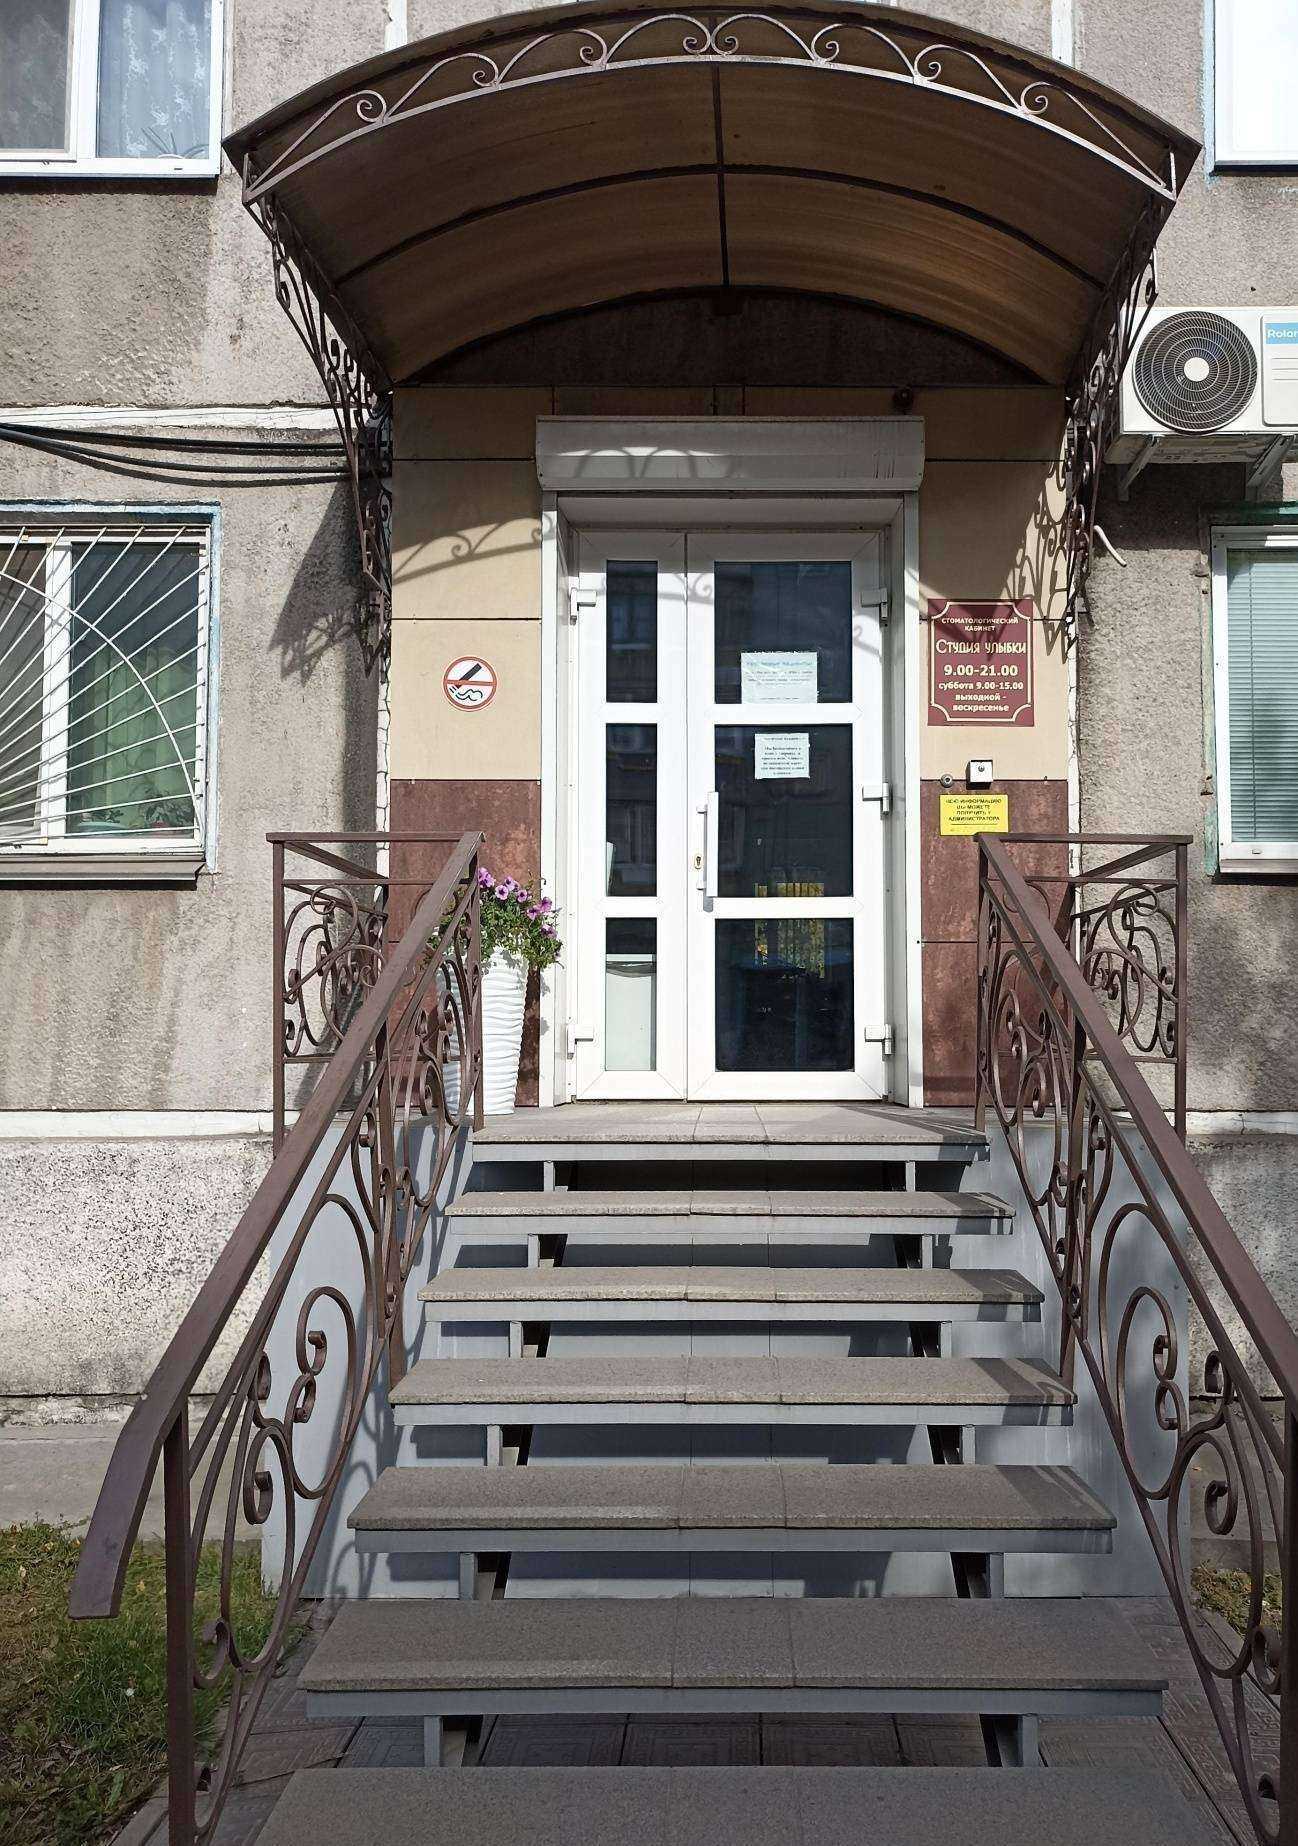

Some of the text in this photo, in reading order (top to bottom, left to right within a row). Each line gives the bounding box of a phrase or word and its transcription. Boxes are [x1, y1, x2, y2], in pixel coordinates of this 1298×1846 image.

[941, 616, 1019, 624] СТОМАТОЛОГИЧЕСКИЙ
[943, 664, 1019, 677] 9.00-21.00
[938, 681, 1024, 691] суббота 9.00-15.00
[955, 693, 1001, 701] выходной
[952, 704, 1010, 713] воскресенье
